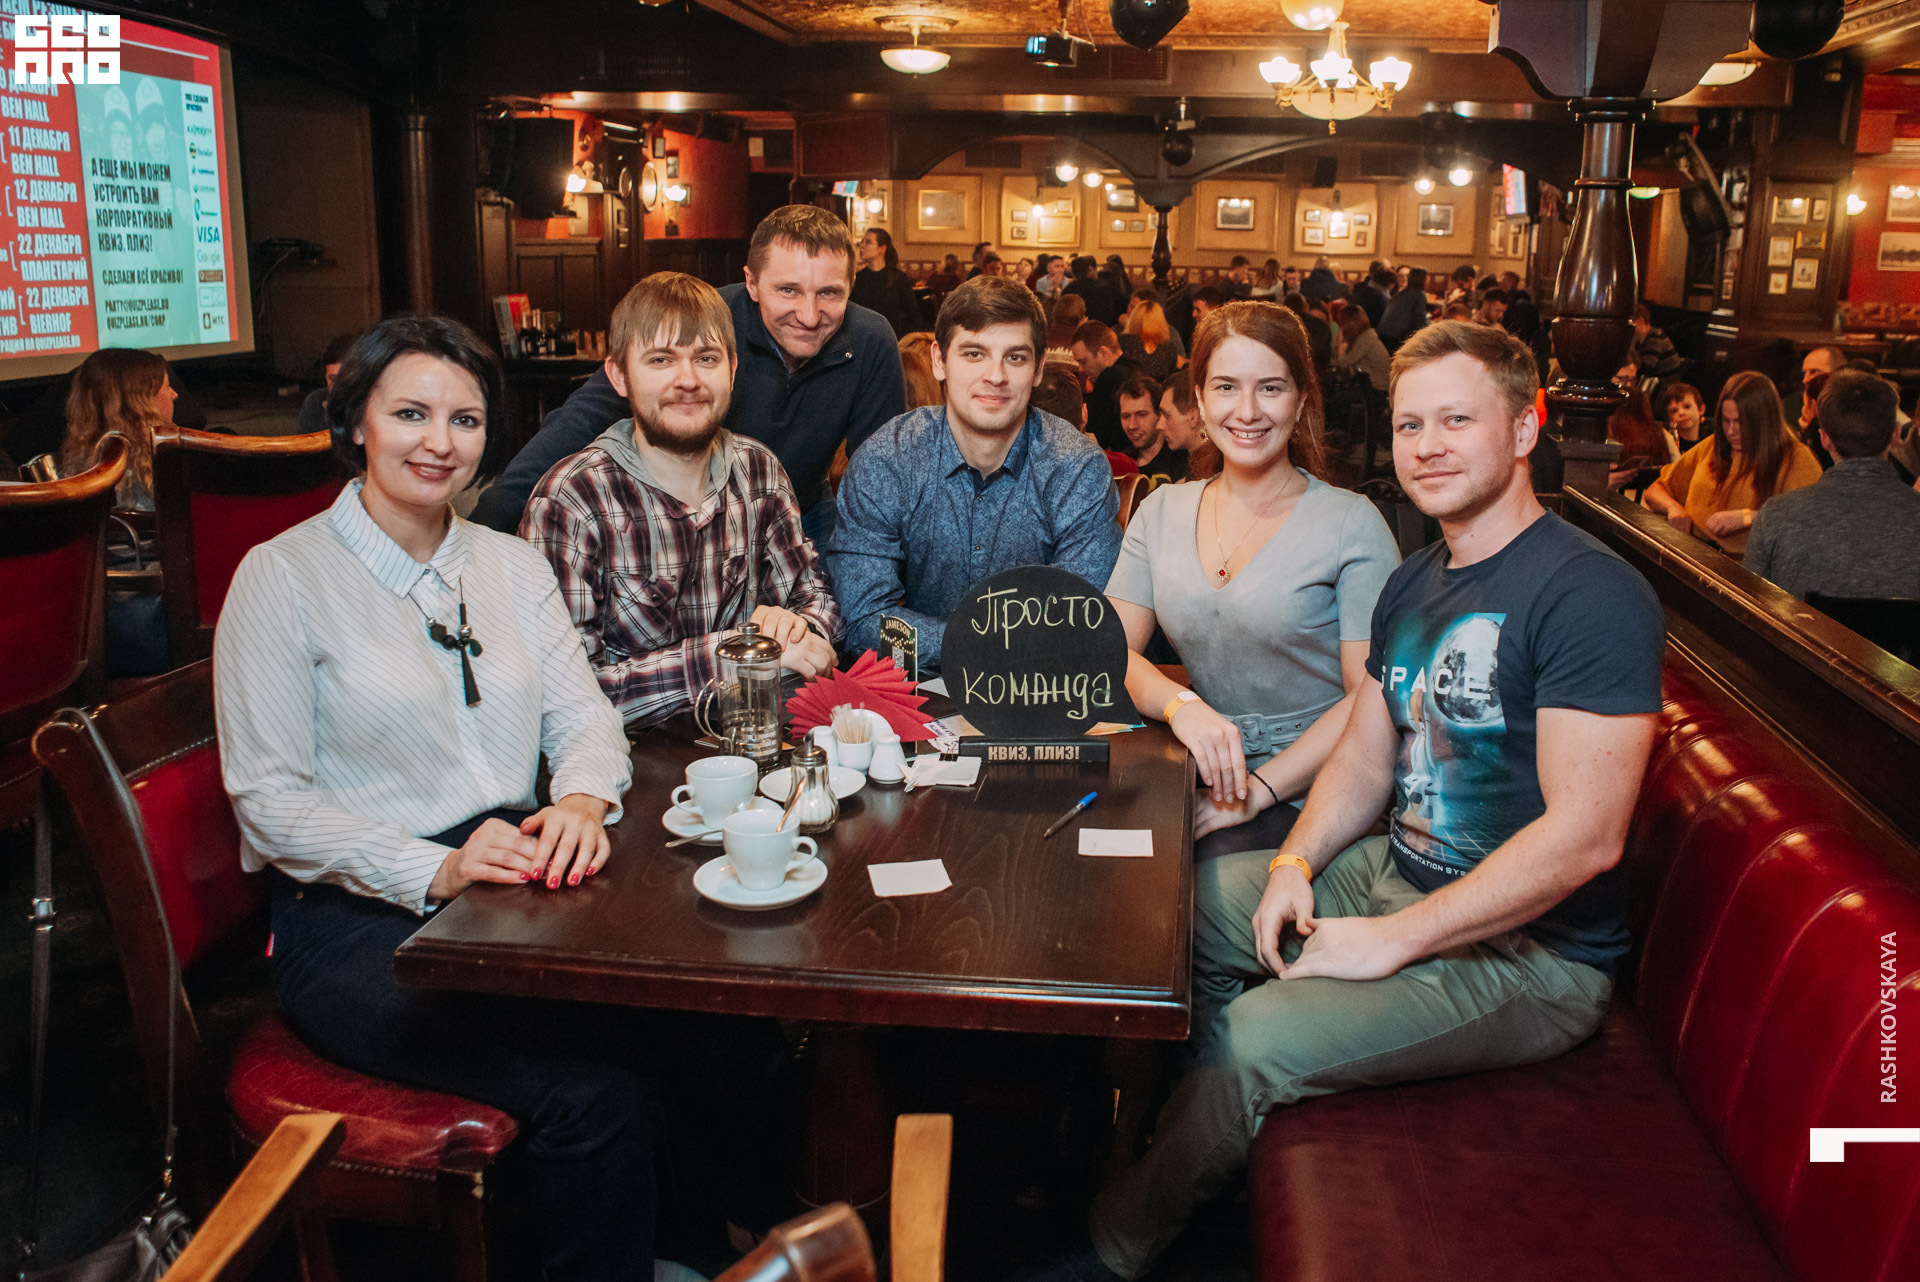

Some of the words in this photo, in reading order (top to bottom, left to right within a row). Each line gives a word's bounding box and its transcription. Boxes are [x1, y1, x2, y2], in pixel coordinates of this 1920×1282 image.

[1, 95, 24, 120] BEN
[24, 98, 50, 123] HALL
[8, 125, 21, 147] 11
[22, 126, 71, 152] ДЕКАБРЯ
[11, 152, 34, 175] BEN
[34, 154, 60, 177] HALL
[92, 158, 98, 176] А
[99, 158, 118, 181] ЕЩЕ
[120, 160, 137, 180] МЫ
[139, 162, 171, 182] МОЖЕМ
[14, 179, 28, 200] 12
[30, 179, 78, 204] ДЕКАБРЯ
[93, 183, 139, 203] УСТРОИТЬ
[141, 186, 159, 205] ВАМ
[16, 206, 39, 228] BEN
[40, 206, 65, 228] HALL
[96, 208, 173, 229] КОРПОРАТИВНЫЙ
[17, 233, 33, 254] 22
[34, 233, 82, 257] ДЕКАБРЯ
[98, 233, 125, 253] КВИЗ,
[126, 233, 153, 252] ПЛИЗ!
[197, 226, 220, 243] VISA
[21, 257, 88, 281] ПЛАНЕТАРИЙ
[102, 269, 135, 286] СДЕЛАЕМ
[0, 286, 16, 310] ИЙ
[26, 287, 41, 308] 22
[42, 286, 89, 310] ДЕКАБРЯ
[29, 312, 71, 334] BIERHOF
[885, 620, 911, 638] JAMESON
[971, 586, 1104, 650] Просто
[988, 746, 1031, 762] КВИЗ,
[1034, 746, 1080, 761] ПЛИЗ!
